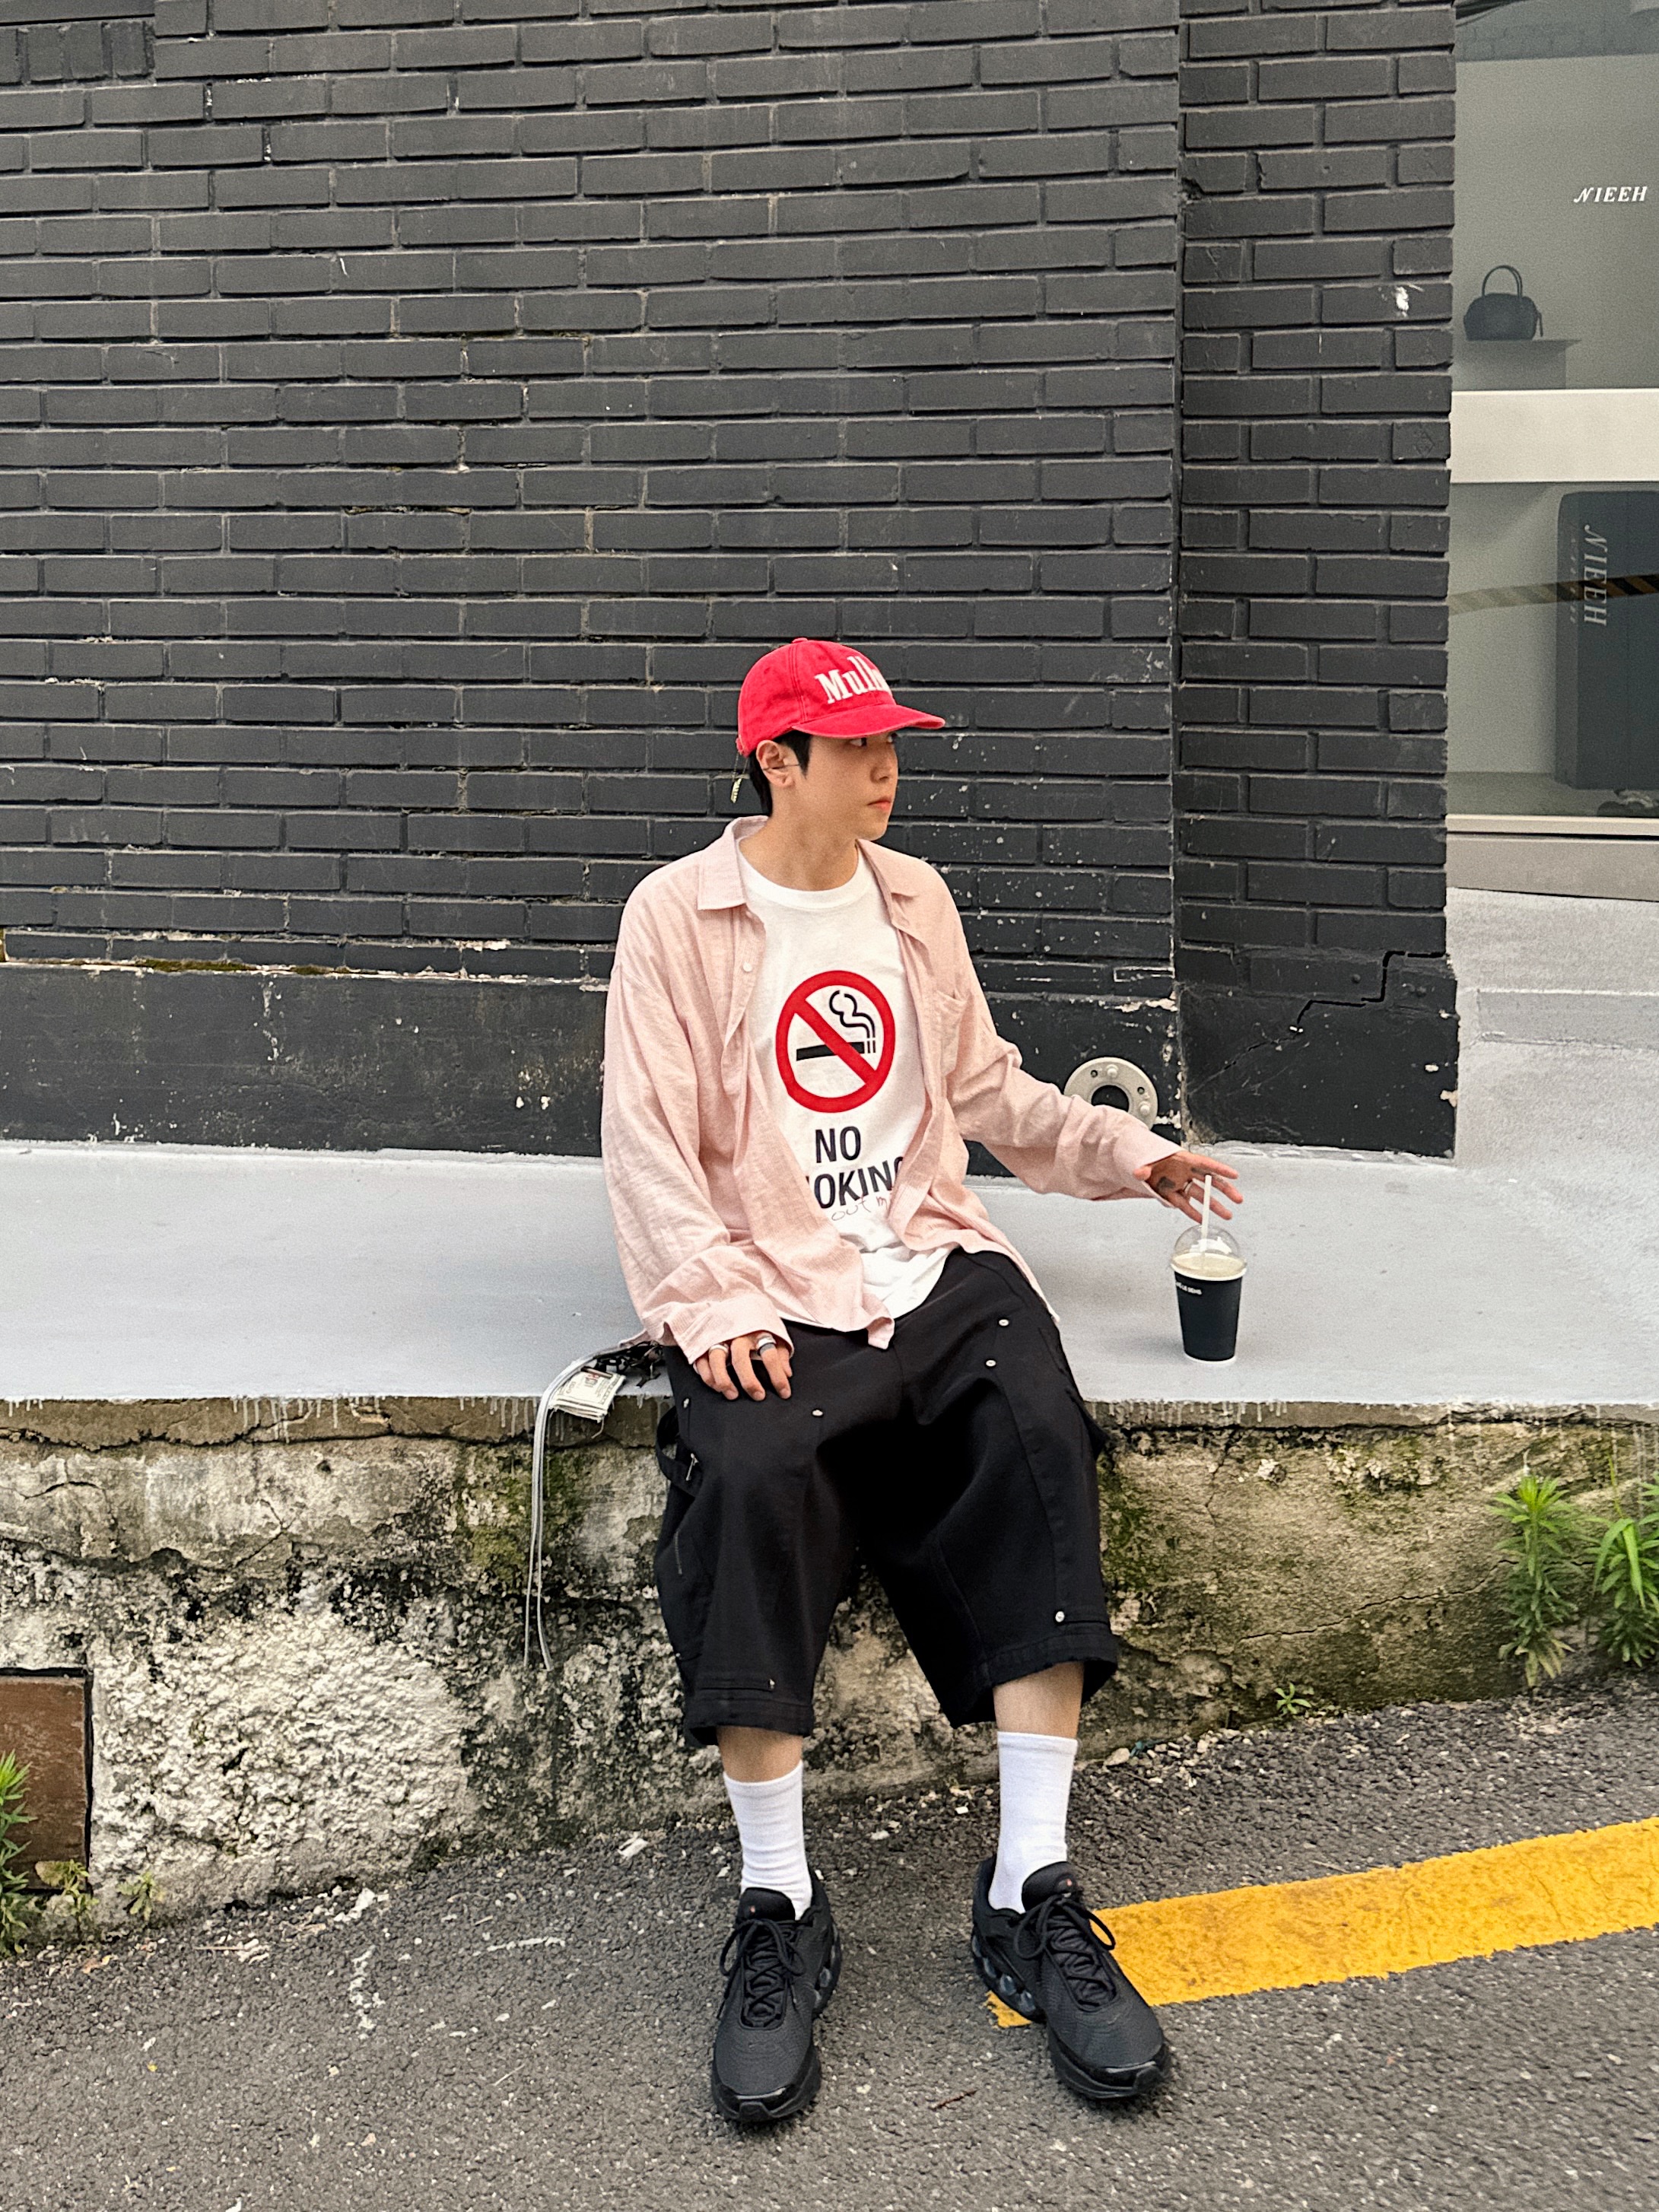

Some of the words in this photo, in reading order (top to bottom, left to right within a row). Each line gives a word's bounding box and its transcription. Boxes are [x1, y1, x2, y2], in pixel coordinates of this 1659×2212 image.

[1573, 186, 1648, 203] NIEEH
[1584, 524, 1607, 626] NIEEH
[815, 1126, 861, 1164] NO
[806, 1156, 903, 1209] OKIN
